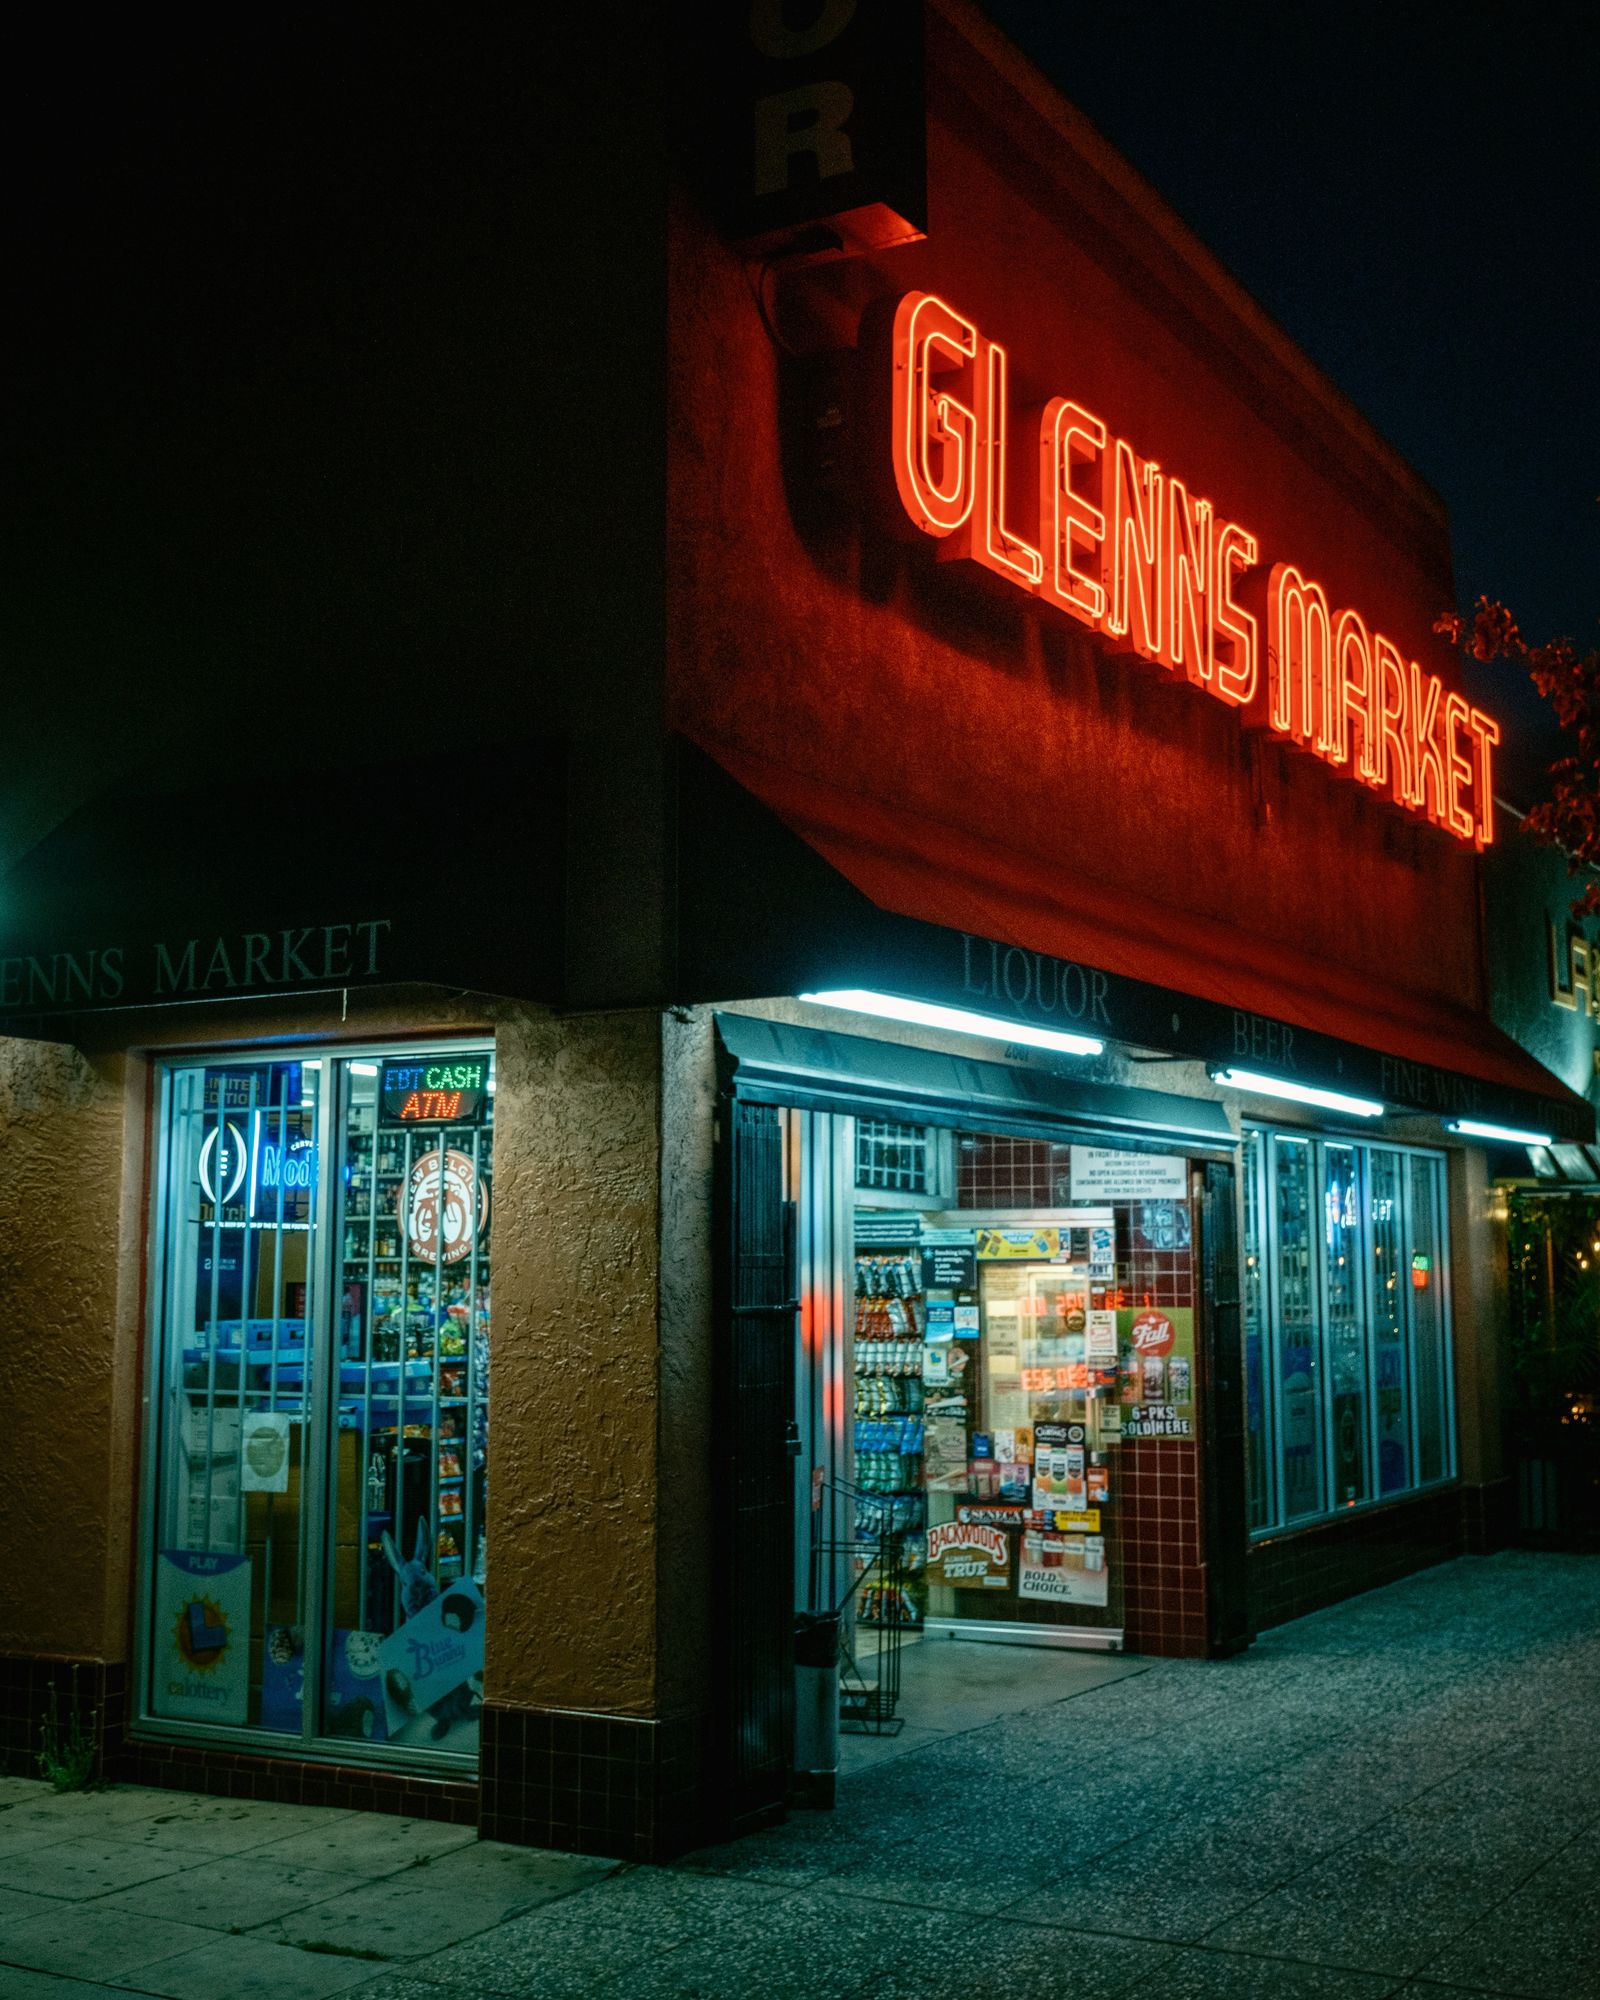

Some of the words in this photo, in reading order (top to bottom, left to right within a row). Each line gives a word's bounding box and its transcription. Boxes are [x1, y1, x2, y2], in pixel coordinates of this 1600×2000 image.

[893, 290, 1258, 706] GLENNS
[1267, 562, 1500, 852] MARKET
[152, 919, 393, 996] MARKET
[961, 933, 1112, 1026] LIQUOR
[1233, 1011, 1297, 1070] BEER
[385, 1068, 424, 1091] EBT
[426, 1066, 481, 1089] CASH
[1380, 1056, 1430, 1103] FINE
[400, 1092, 461, 1119] ATM
[934, 1249, 958, 1257] Smoking
[1132, 1321, 1170, 1348] Fall
[1132, 1406, 1175, 1420] 6-PKS
[1120, 1421, 1151, 1436] SOLD
[1156, 1420, 1189, 1434] HERE
[969, 1509, 1022, 1523] SENECA
[928, 1522, 1007, 1565] BACKWOODS
[188, 1557, 218, 1570] PLAY
[943, 1561, 989, 1578] TRUE
[1023, 1582, 1072, 1595] CHOICE.
[1024, 1570, 1059, 1583] BOLD.
